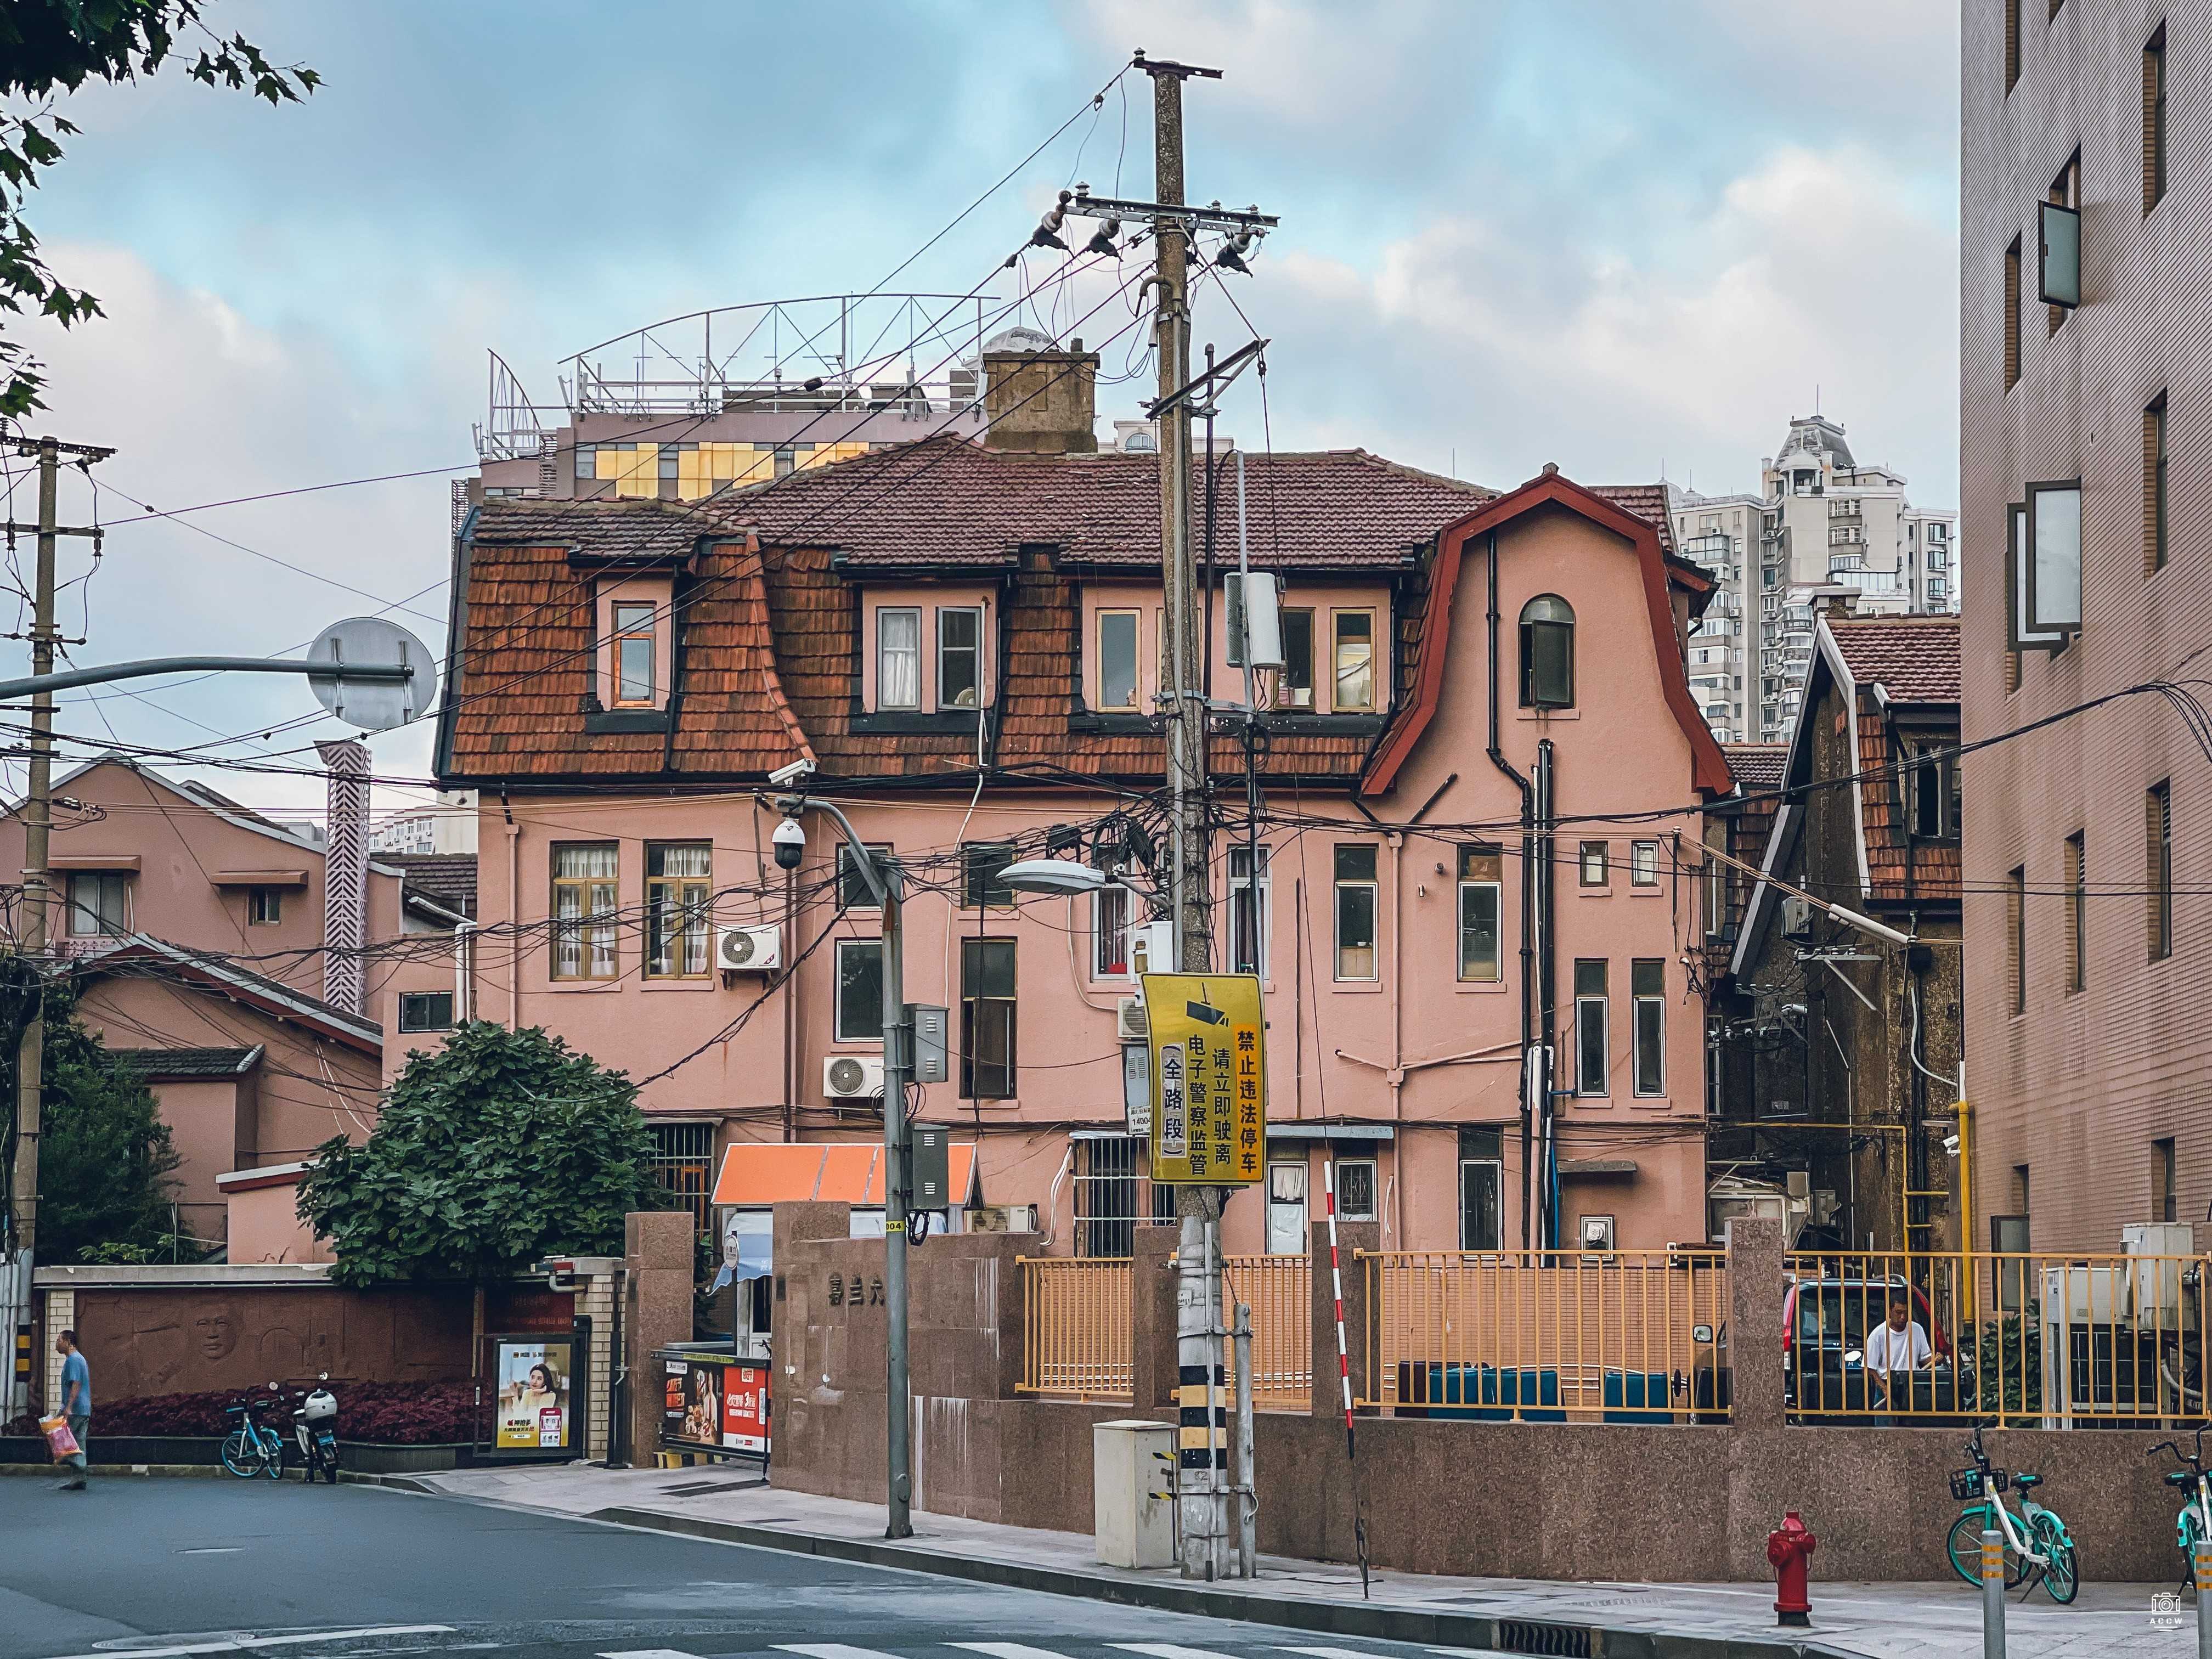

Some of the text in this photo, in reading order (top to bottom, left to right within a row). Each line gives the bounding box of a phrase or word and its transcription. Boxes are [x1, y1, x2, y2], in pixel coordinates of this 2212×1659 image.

[1188, 1034, 1207, 1176] 电子警察监管
[1212, 1048, 1231, 1164] 请立即驶离
[1238, 1030, 1257, 1173] 禁止违法停车
